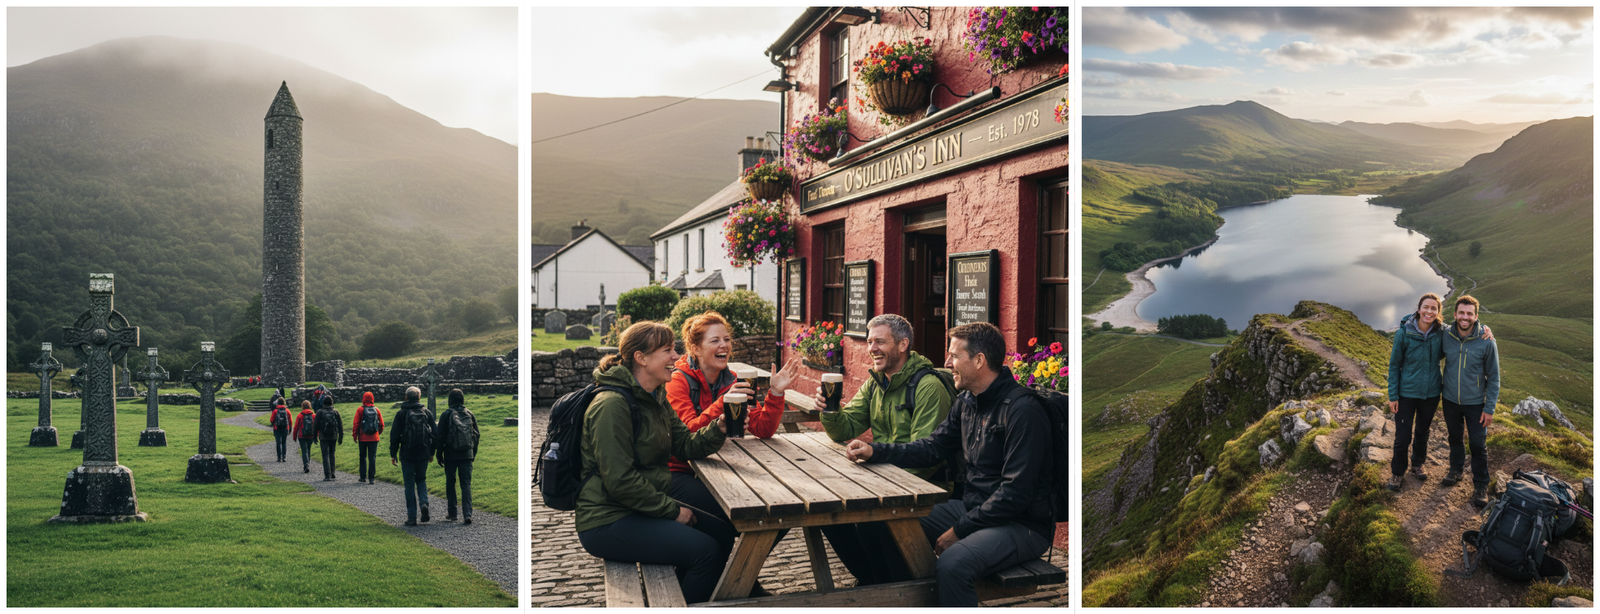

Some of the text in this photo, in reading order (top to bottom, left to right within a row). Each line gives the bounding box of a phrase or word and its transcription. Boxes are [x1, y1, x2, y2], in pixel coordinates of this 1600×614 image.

[844, 109, 1039, 193] O'SULLIVAN'S INN Est. 1978
